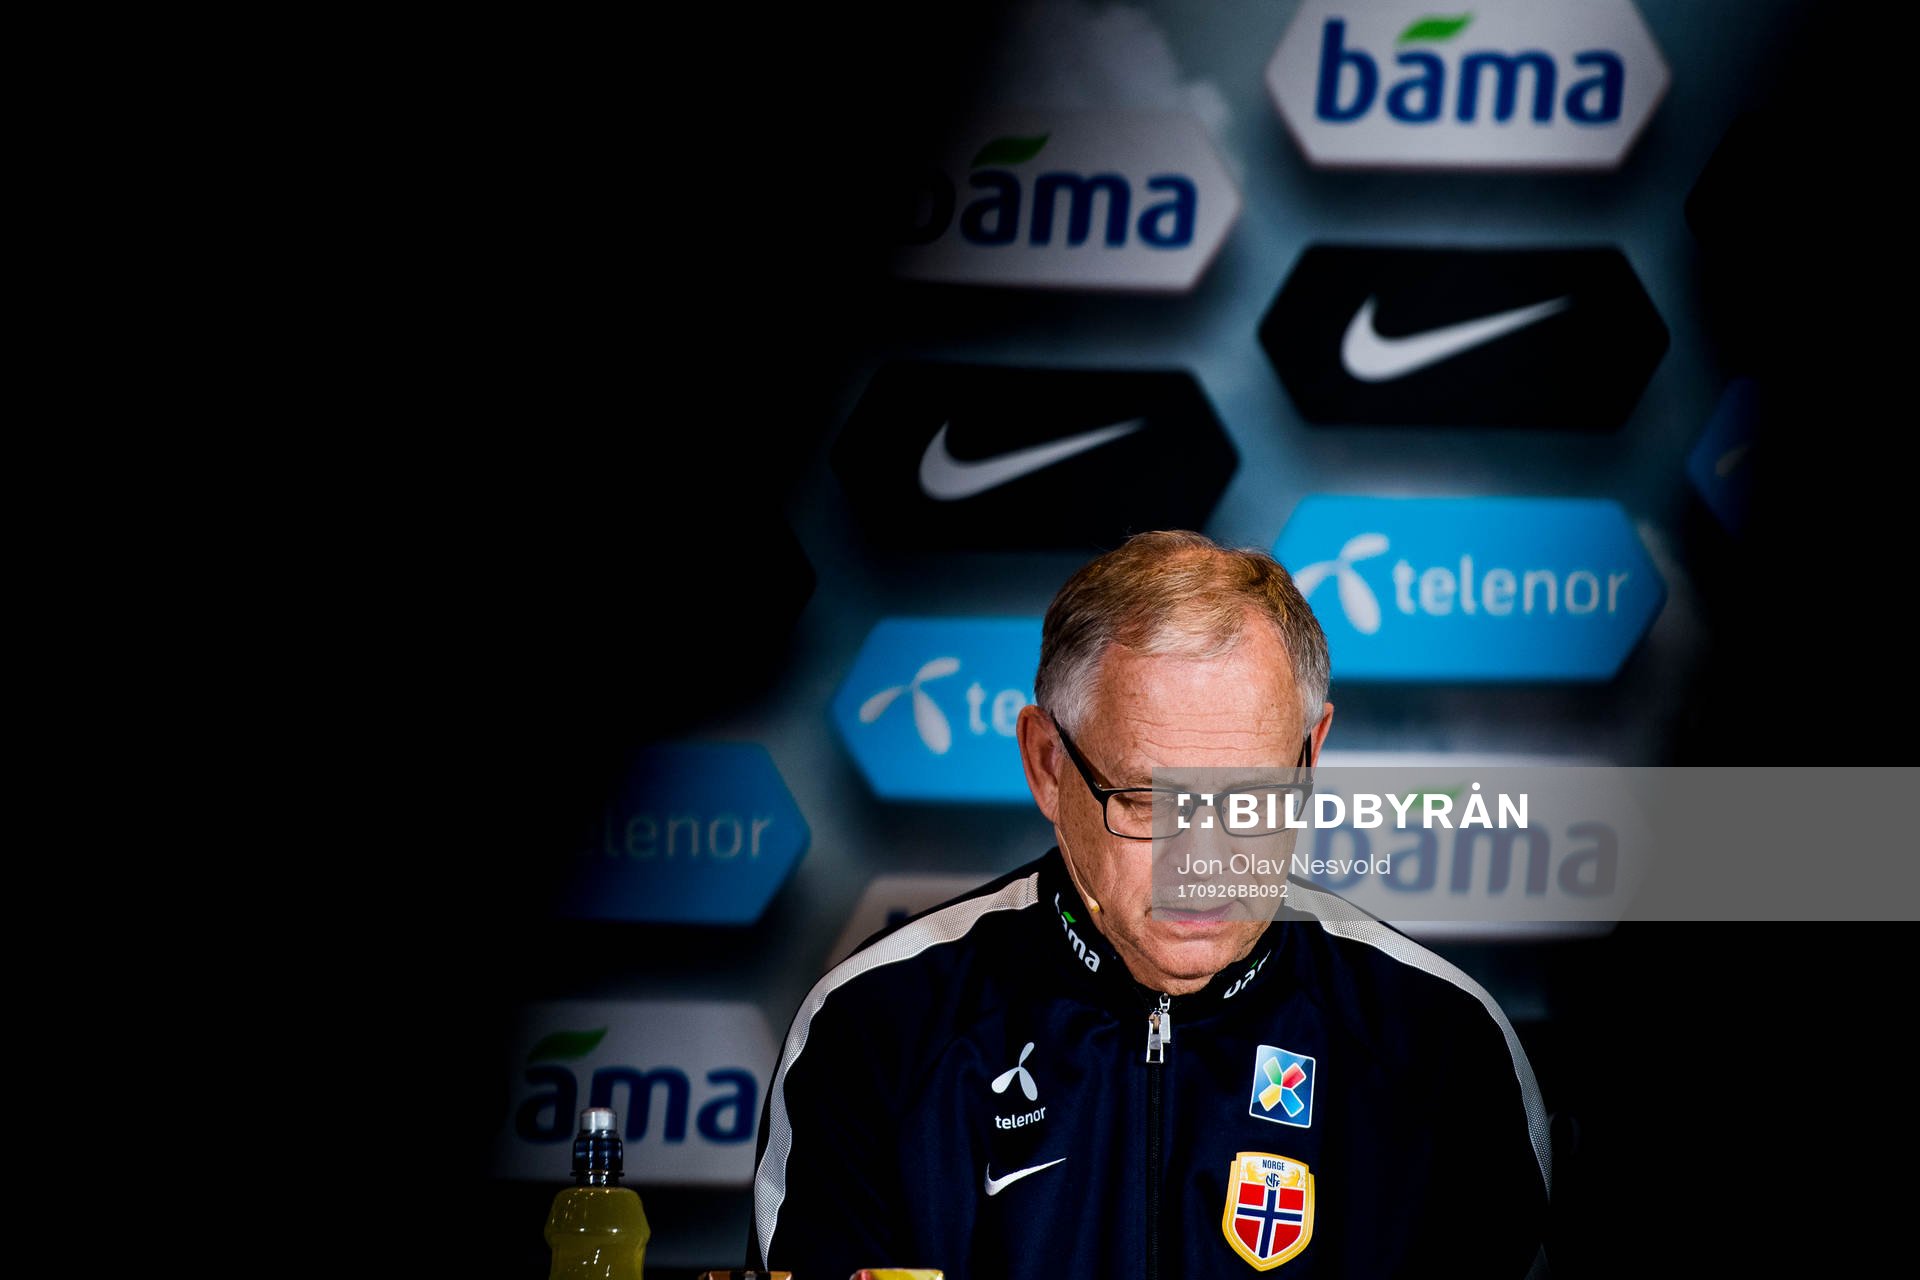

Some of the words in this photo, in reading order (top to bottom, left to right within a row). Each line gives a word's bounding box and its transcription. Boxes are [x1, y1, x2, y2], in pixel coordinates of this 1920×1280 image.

[1315, 20, 1626, 125] bama
[1391, 553, 1630, 618] telenor
[1311, 788, 1620, 902] bama
[514, 1064, 758, 1145] ama
[994, 1106, 1047, 1130] telenor
[1261, 1159, 1285, 1172] NORGE
